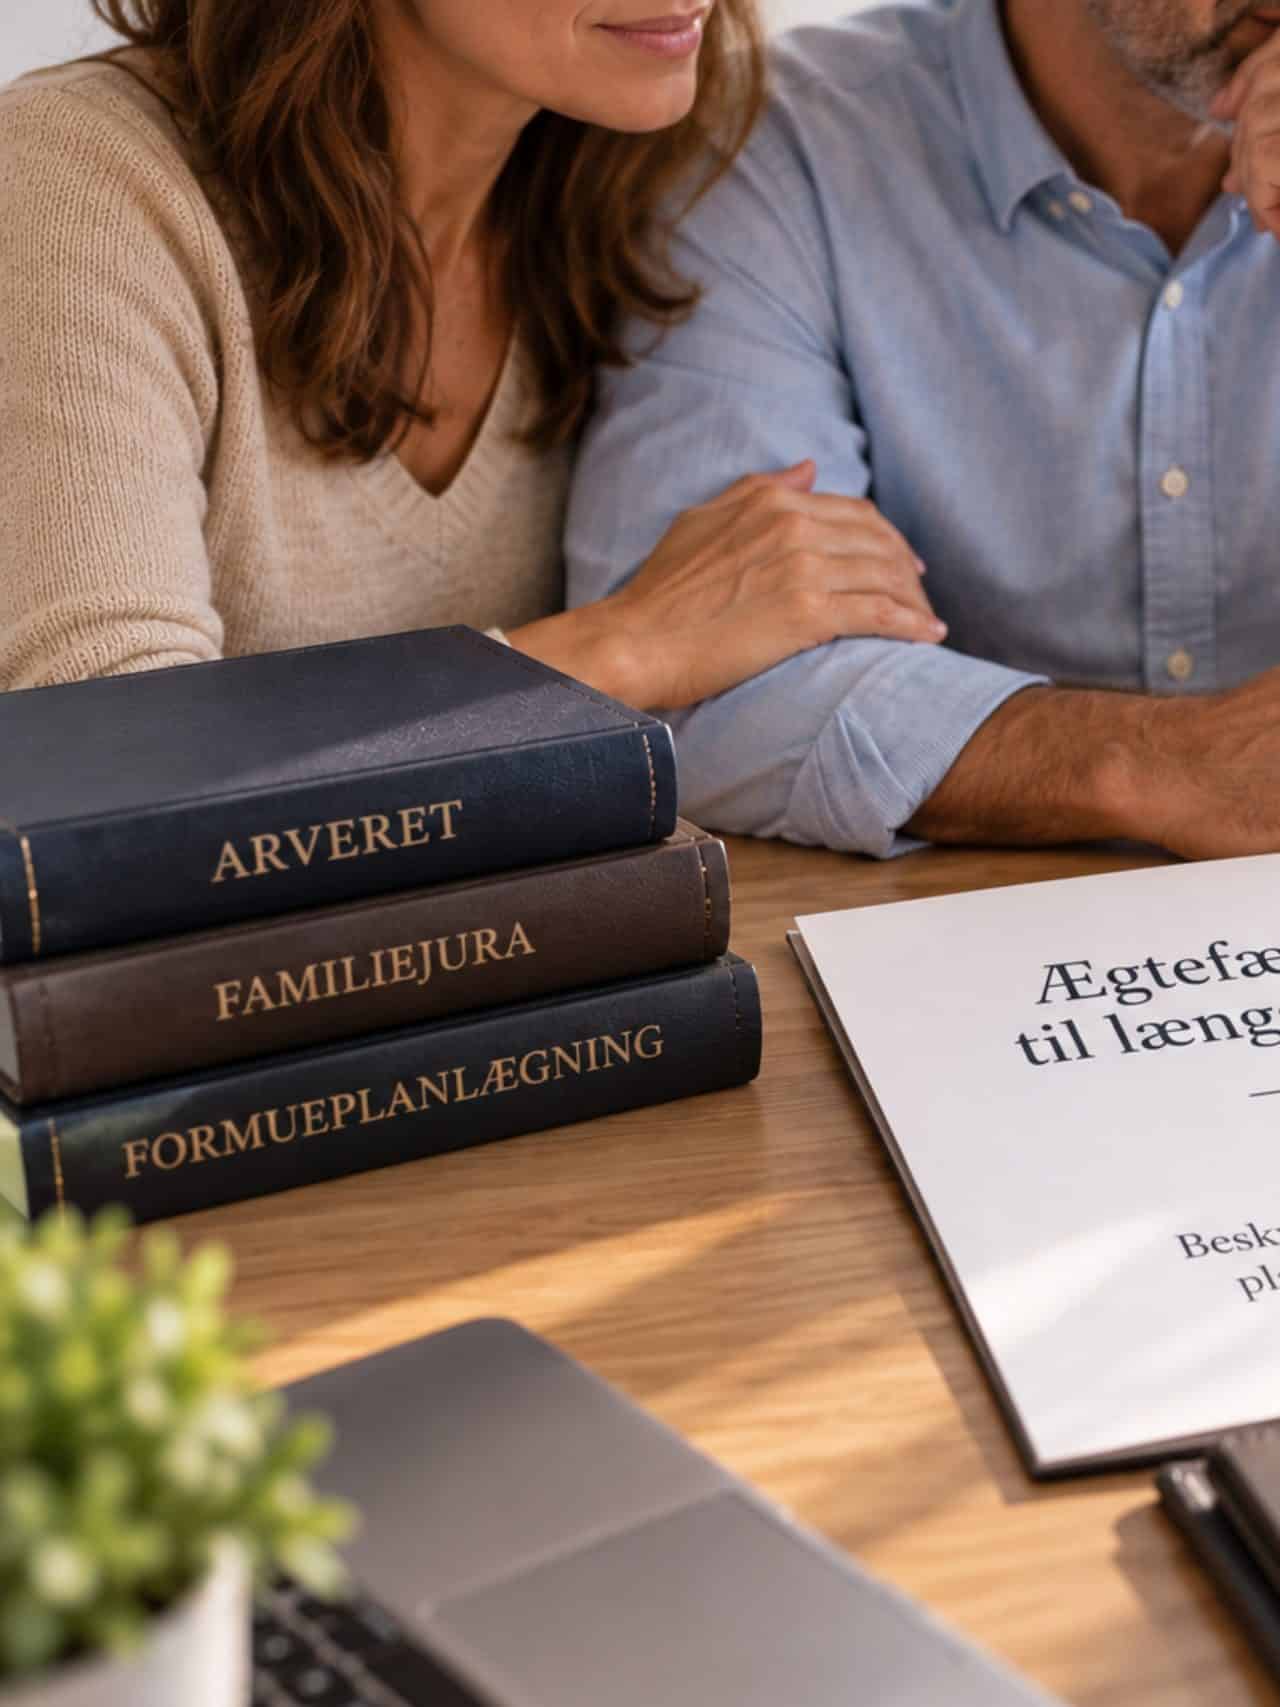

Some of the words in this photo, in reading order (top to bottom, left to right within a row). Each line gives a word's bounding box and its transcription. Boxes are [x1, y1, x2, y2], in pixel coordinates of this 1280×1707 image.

[211, 800, 463, 883] ARVERET
[214, 922, 535, 1020] FAMILIEJURA
[1015, 1020, 1094, 1066] til
[123, 1025, 664, 1177] FORMUEPLANLÆGNING
